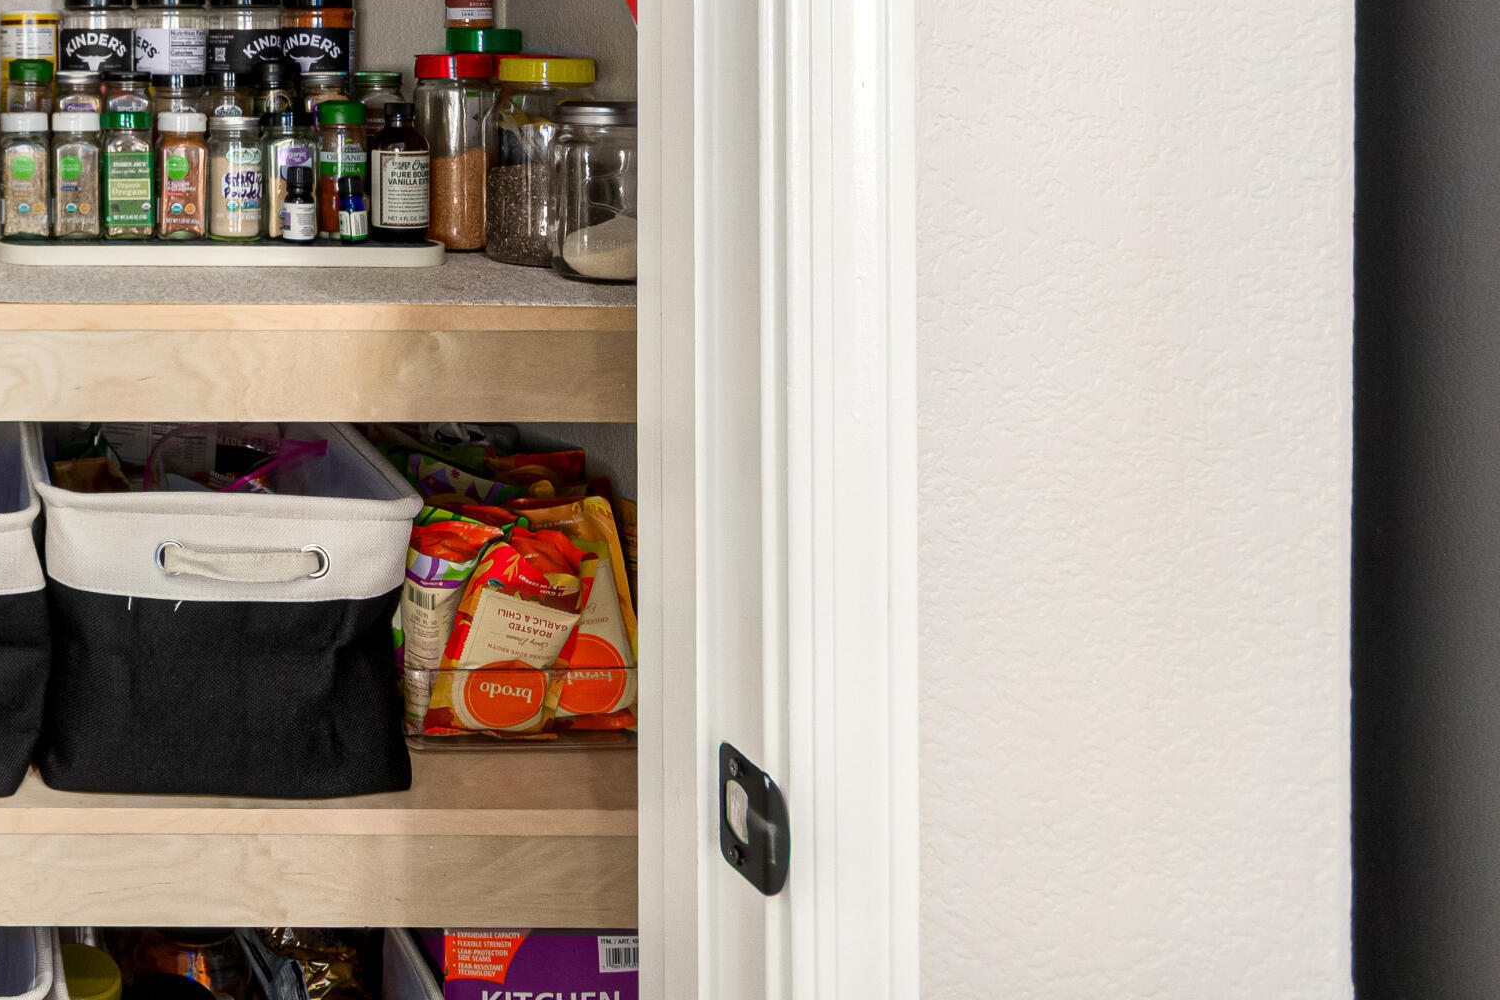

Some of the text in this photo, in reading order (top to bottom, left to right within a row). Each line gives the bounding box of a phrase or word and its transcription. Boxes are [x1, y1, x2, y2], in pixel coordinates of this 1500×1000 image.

[66, 32, 127, 57] KINDER'S
[498, 608, 568, 632] GARLIC & CHILI
[508, 622, 553, 638] ROASTED
[488, 643, 510, 653] BROTH
[480, 682, 532, 704] brodo
[458, 963, 504, 971] TEAR-RESISTANT
